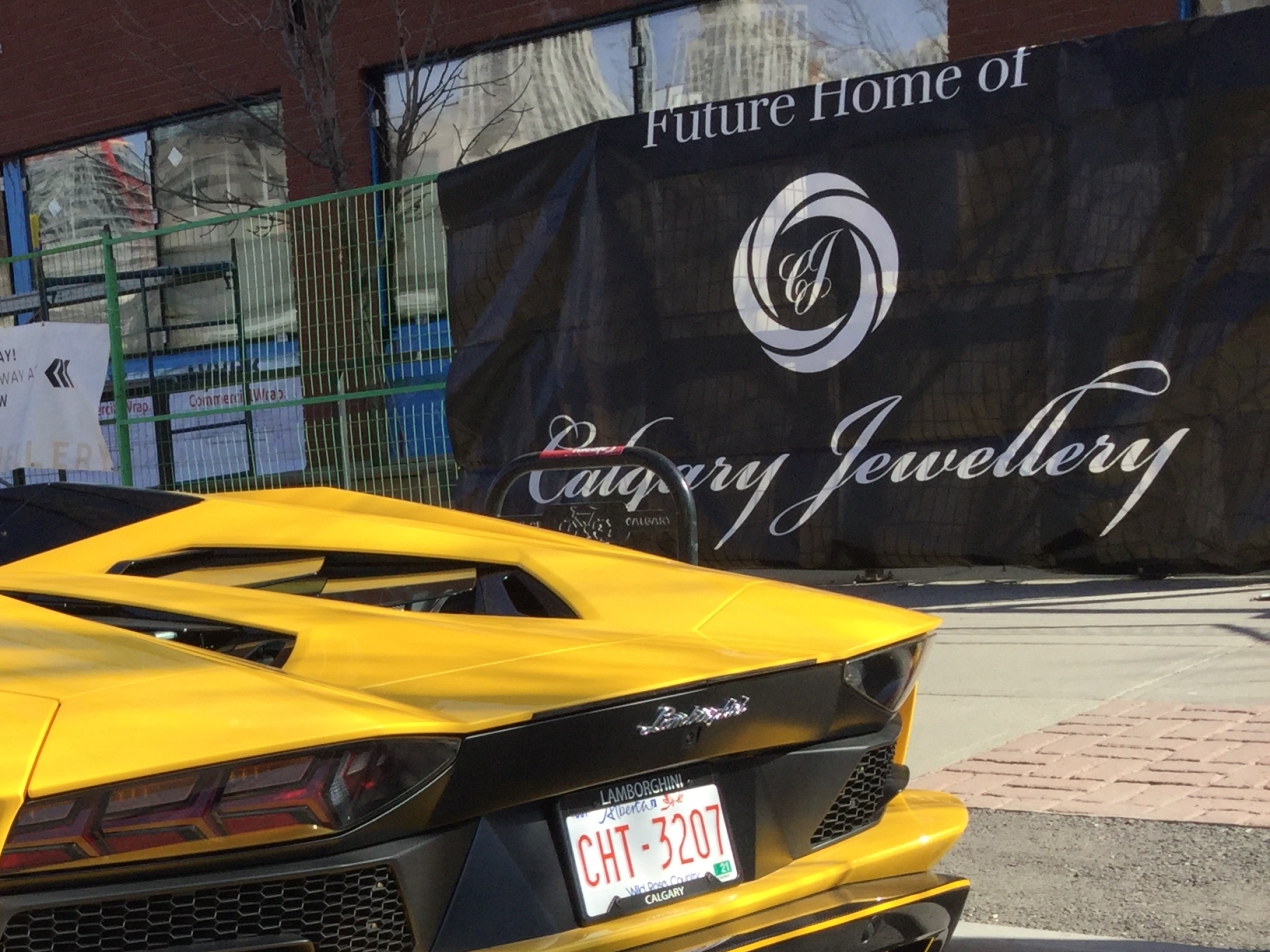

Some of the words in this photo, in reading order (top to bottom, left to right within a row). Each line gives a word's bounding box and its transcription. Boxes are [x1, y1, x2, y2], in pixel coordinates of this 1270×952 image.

[643, 92, 796, 149] Future
[809, 63, 961, 122] Home
[978, 46, 1031, 92] of
[528, 412, 791, 550] Calgary
[770, 360, 1190, 538] Jewellery
[599, 774, 684, 806] LAMBORGHINI
[577, 804, 725, 888] CHT-3207
[720, 863, 730, 874] 21
[644, 886, 685, 905] CALGARY
